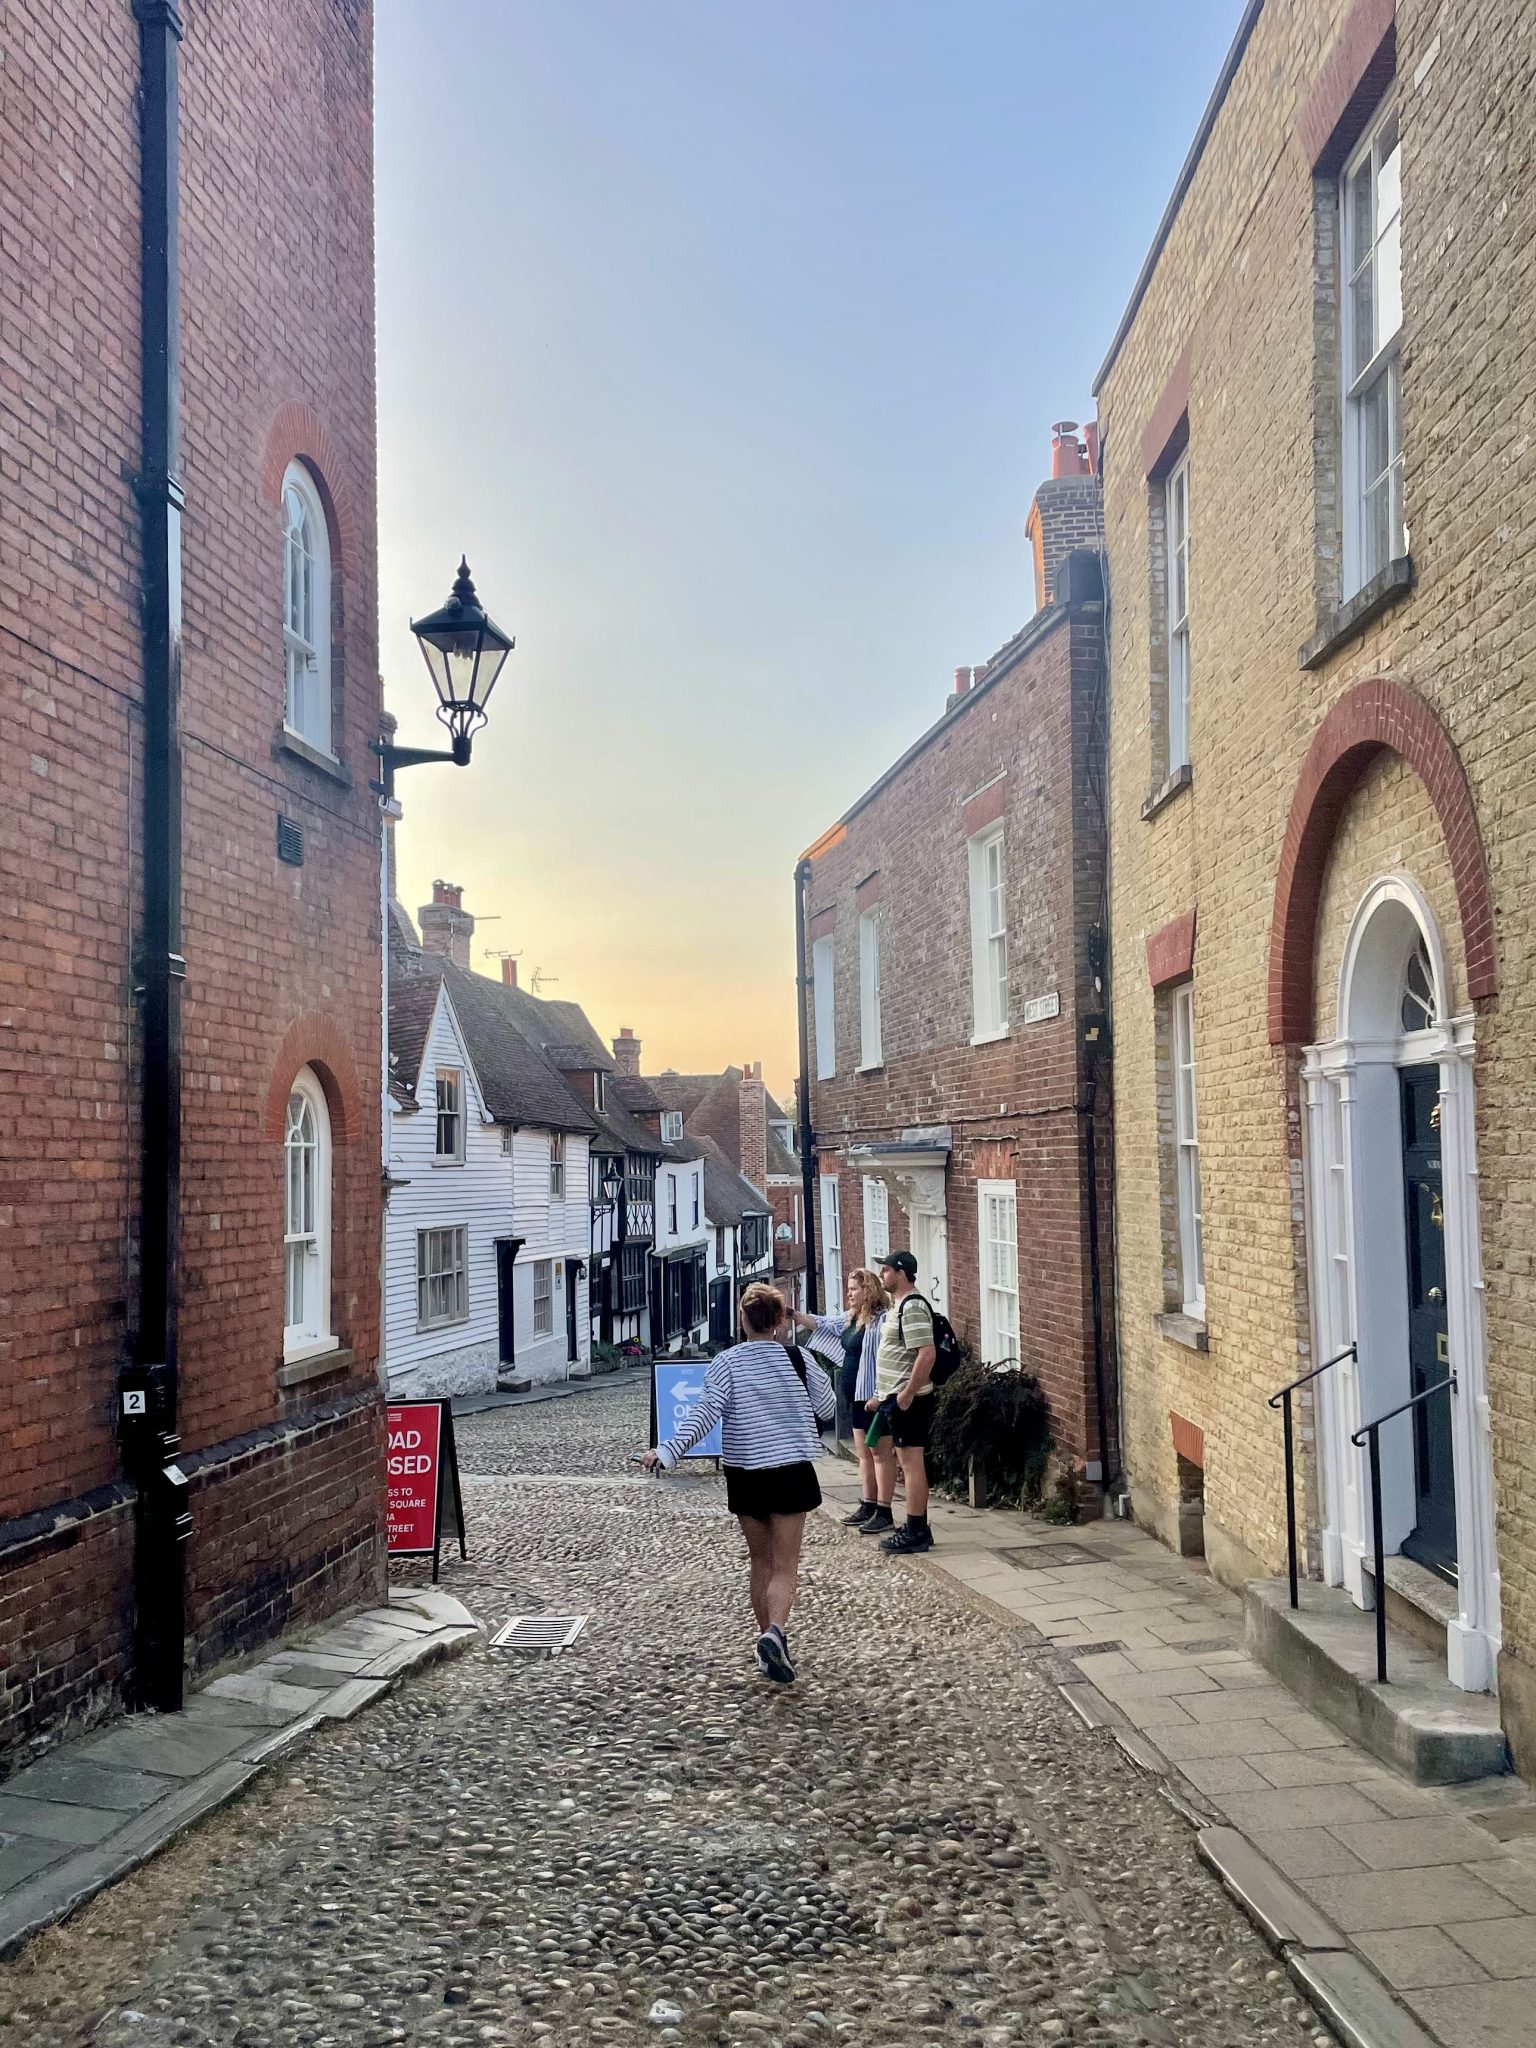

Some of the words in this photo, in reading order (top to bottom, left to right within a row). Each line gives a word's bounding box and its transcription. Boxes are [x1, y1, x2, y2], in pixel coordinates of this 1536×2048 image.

[1039, 995, 1058, 1017] STREET
[129, 1394, 141, 1409] 2
[401, 1487, 413, 1496] TO
[389, 1499, 426, 1509] SQUARE
